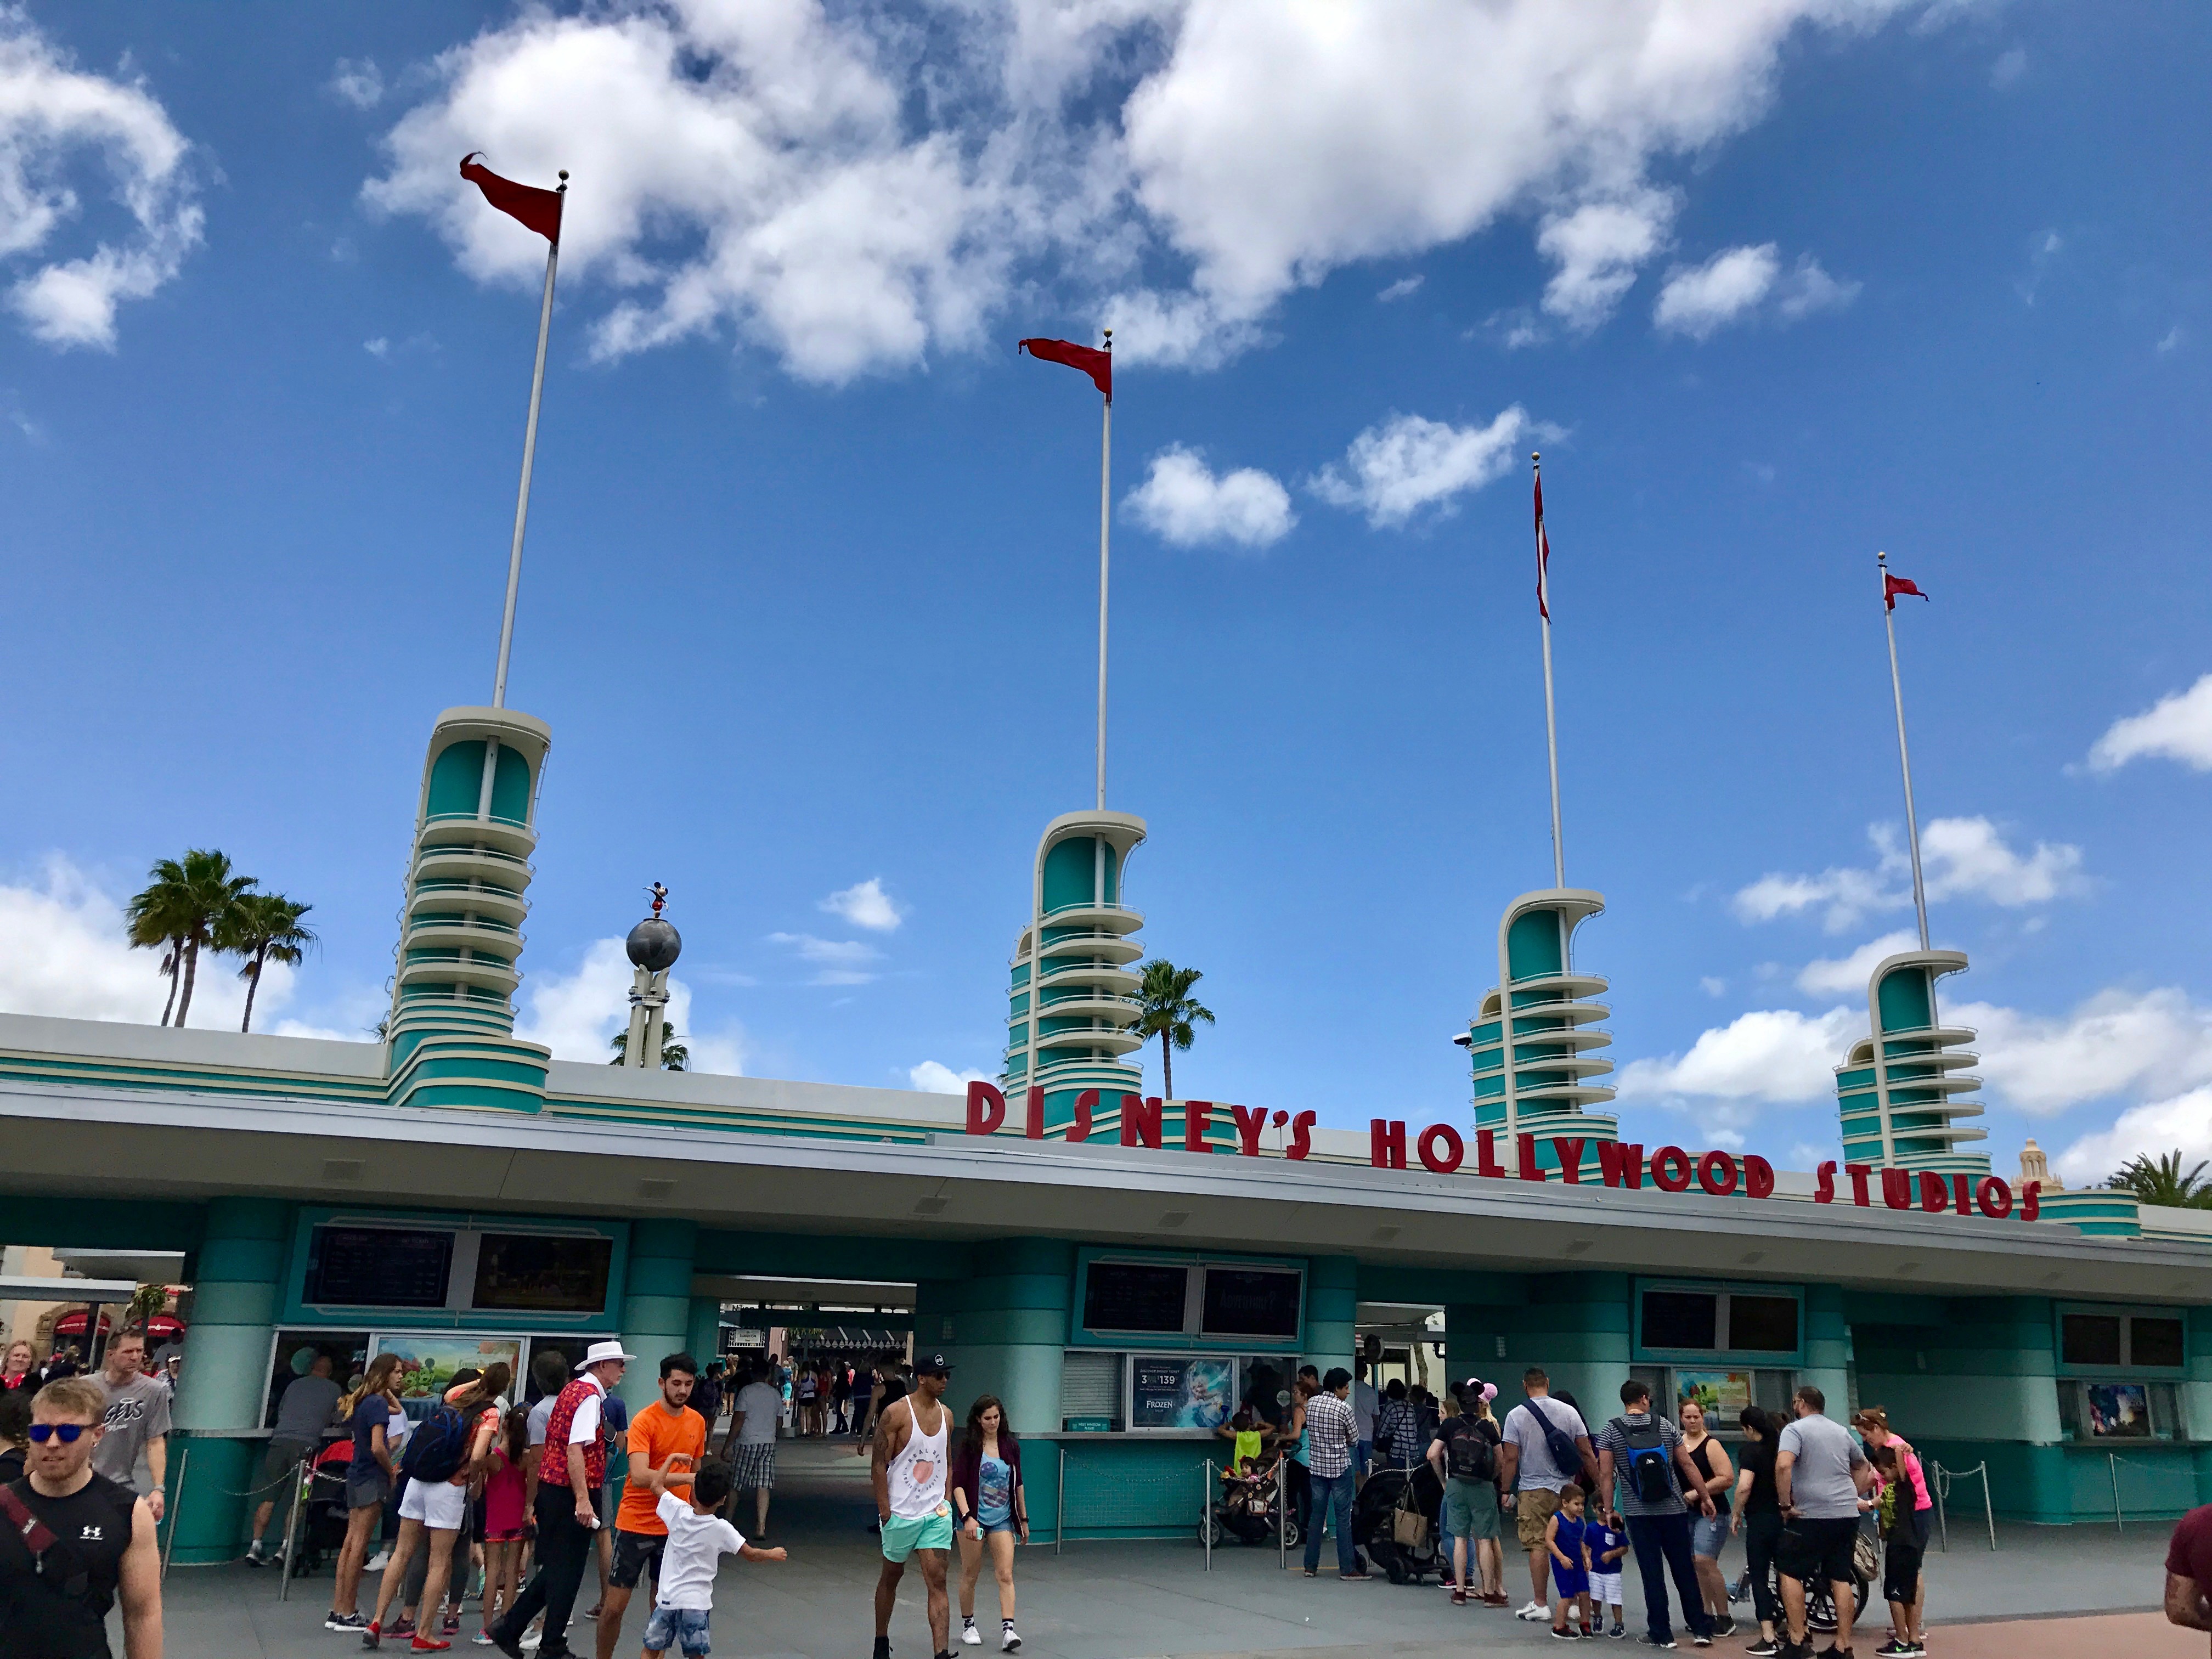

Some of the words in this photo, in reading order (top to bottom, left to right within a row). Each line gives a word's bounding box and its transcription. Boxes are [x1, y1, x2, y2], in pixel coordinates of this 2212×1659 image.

[966, 1081, 1317, 1160] DISNEY'S
[1371, 1118, 1775, 1199] HOLLYWOOD
[1814, 1160, 2042, 1222] STUDIOS
[1142, 1375, 1147, 1384] 3
[1146, 1400, 1173, 1408] FROZEN
[908, 1448, 928, 1463] REAL
